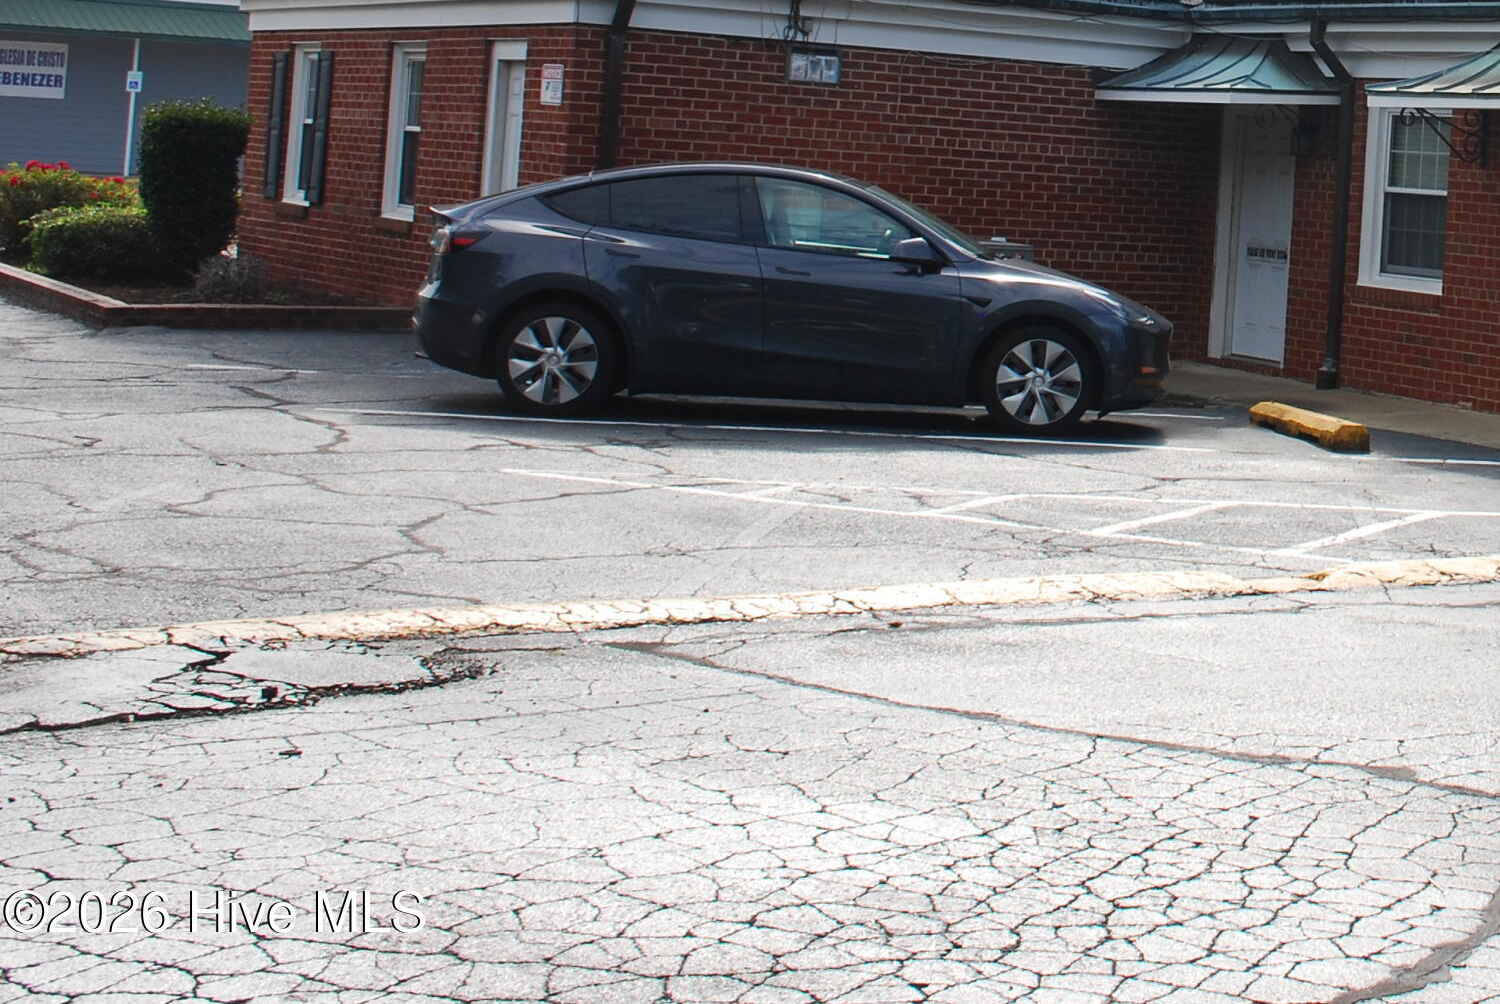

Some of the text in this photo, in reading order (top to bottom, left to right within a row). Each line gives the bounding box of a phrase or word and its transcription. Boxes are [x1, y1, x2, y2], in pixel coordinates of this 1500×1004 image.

[26, 49, 36, 67] DE
[37, 50, 65, 68] CRISTO
[0, 71, 63, 88] BENEZER
